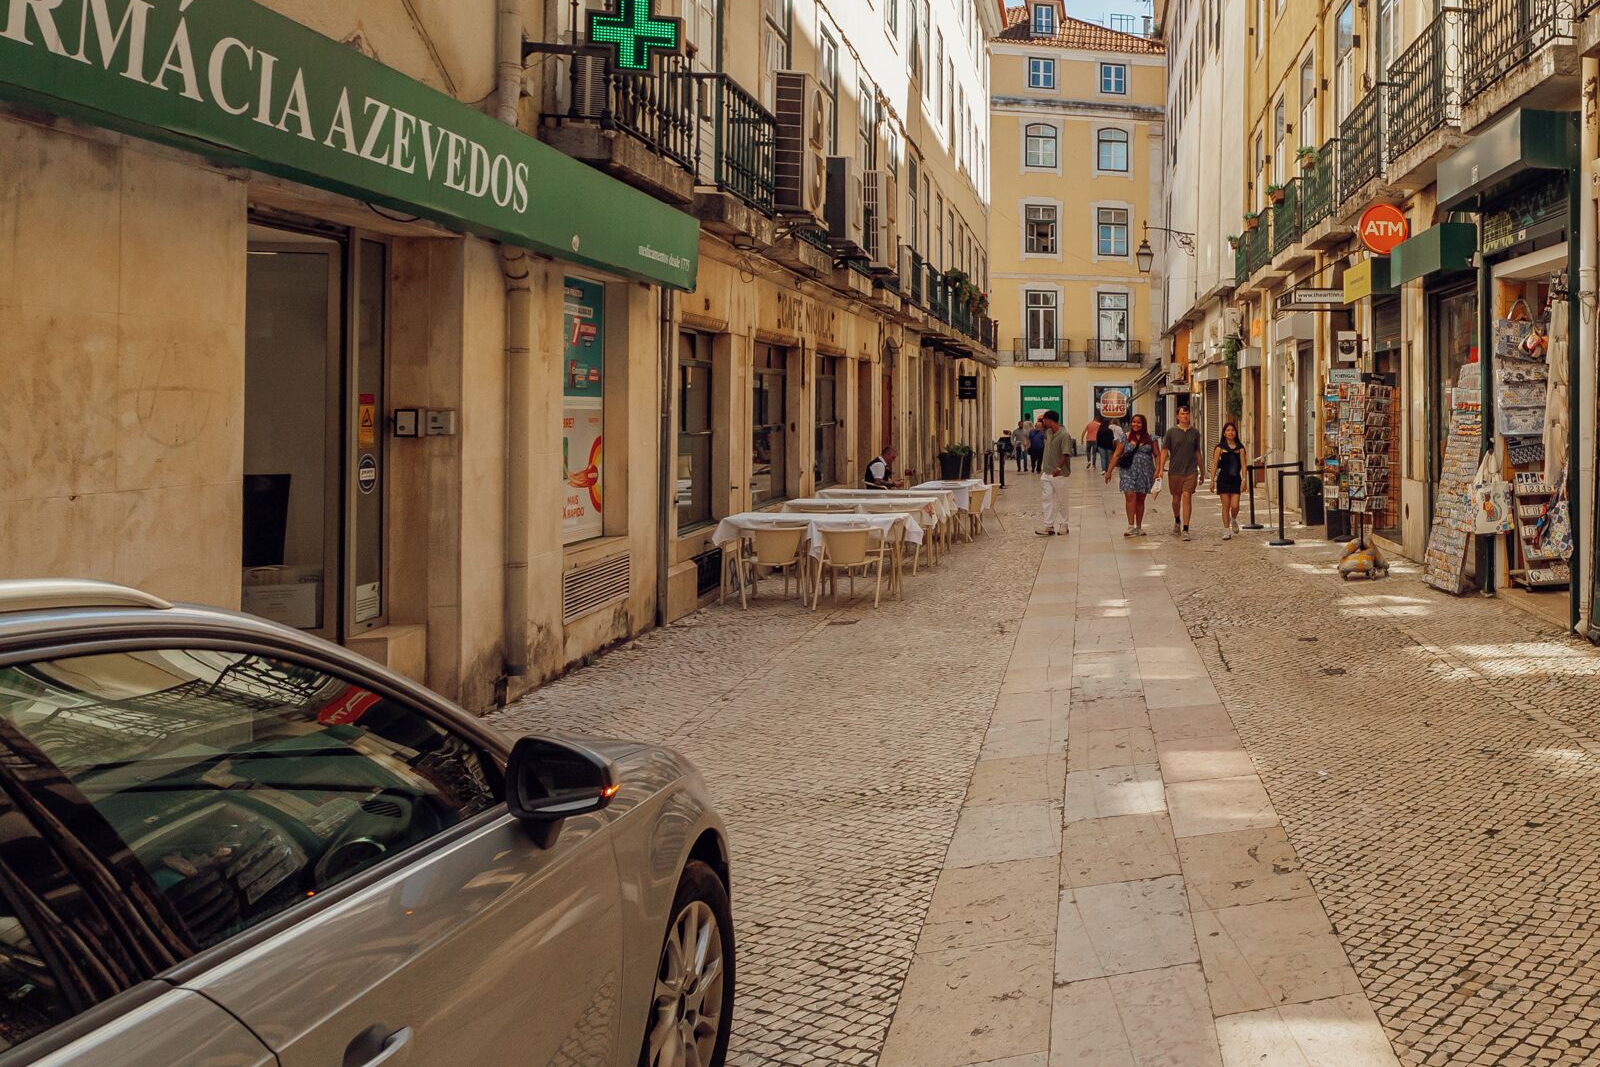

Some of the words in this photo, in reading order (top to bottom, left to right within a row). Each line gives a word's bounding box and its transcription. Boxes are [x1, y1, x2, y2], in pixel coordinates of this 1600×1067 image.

[322, 86, 529, 214] AZEVEDOS
[1365, 220, 1404, 237] ATM
[1101, 404, 1126, 412] KING
